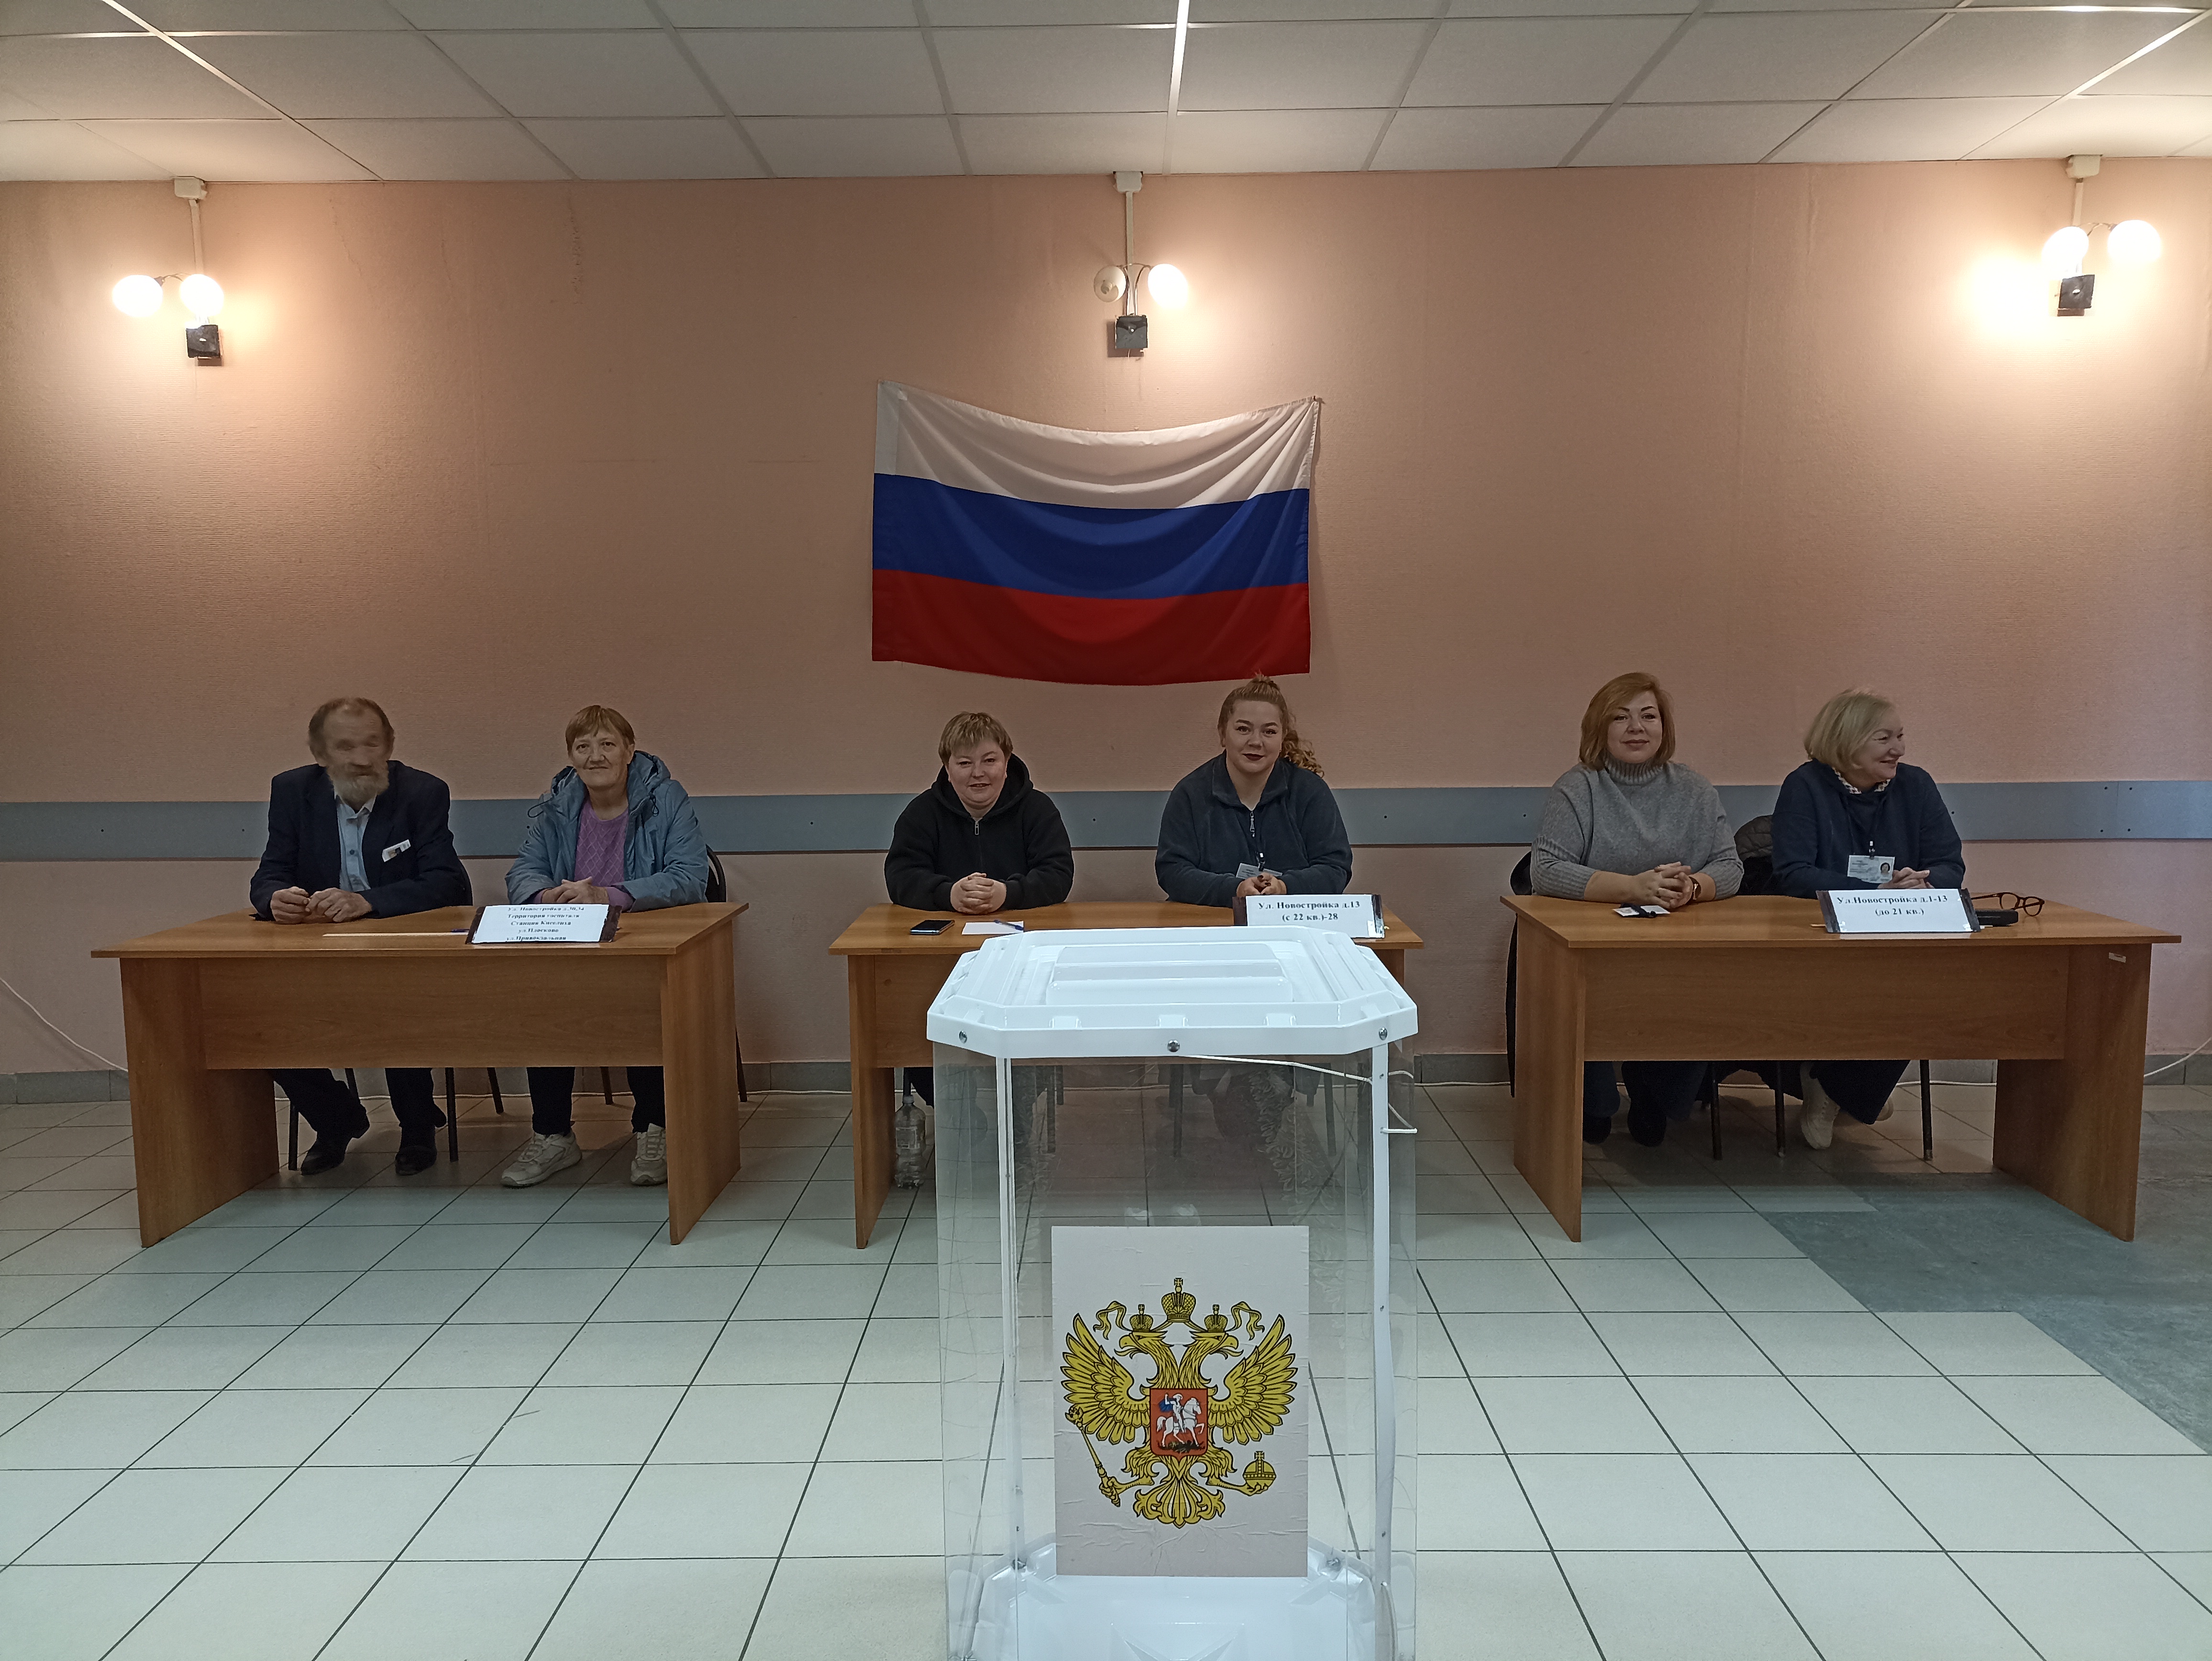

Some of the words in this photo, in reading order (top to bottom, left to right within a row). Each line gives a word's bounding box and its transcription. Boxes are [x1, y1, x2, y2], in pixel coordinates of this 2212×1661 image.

[1836, 896, 1917, 905] Ул.Новостройка
[1920, 895, 1948, 903] д.1-13
[1277, 901, 1339, 910] Новостройка
[1342, 901, 1360, 909] д.13
[1282, 913, 1291, 921] (с
[1306, 913, 1338, 921] кв.)-28
[1875, 908, 1890, 917] (до
[1906, 908, 1924, 916] кв.)
